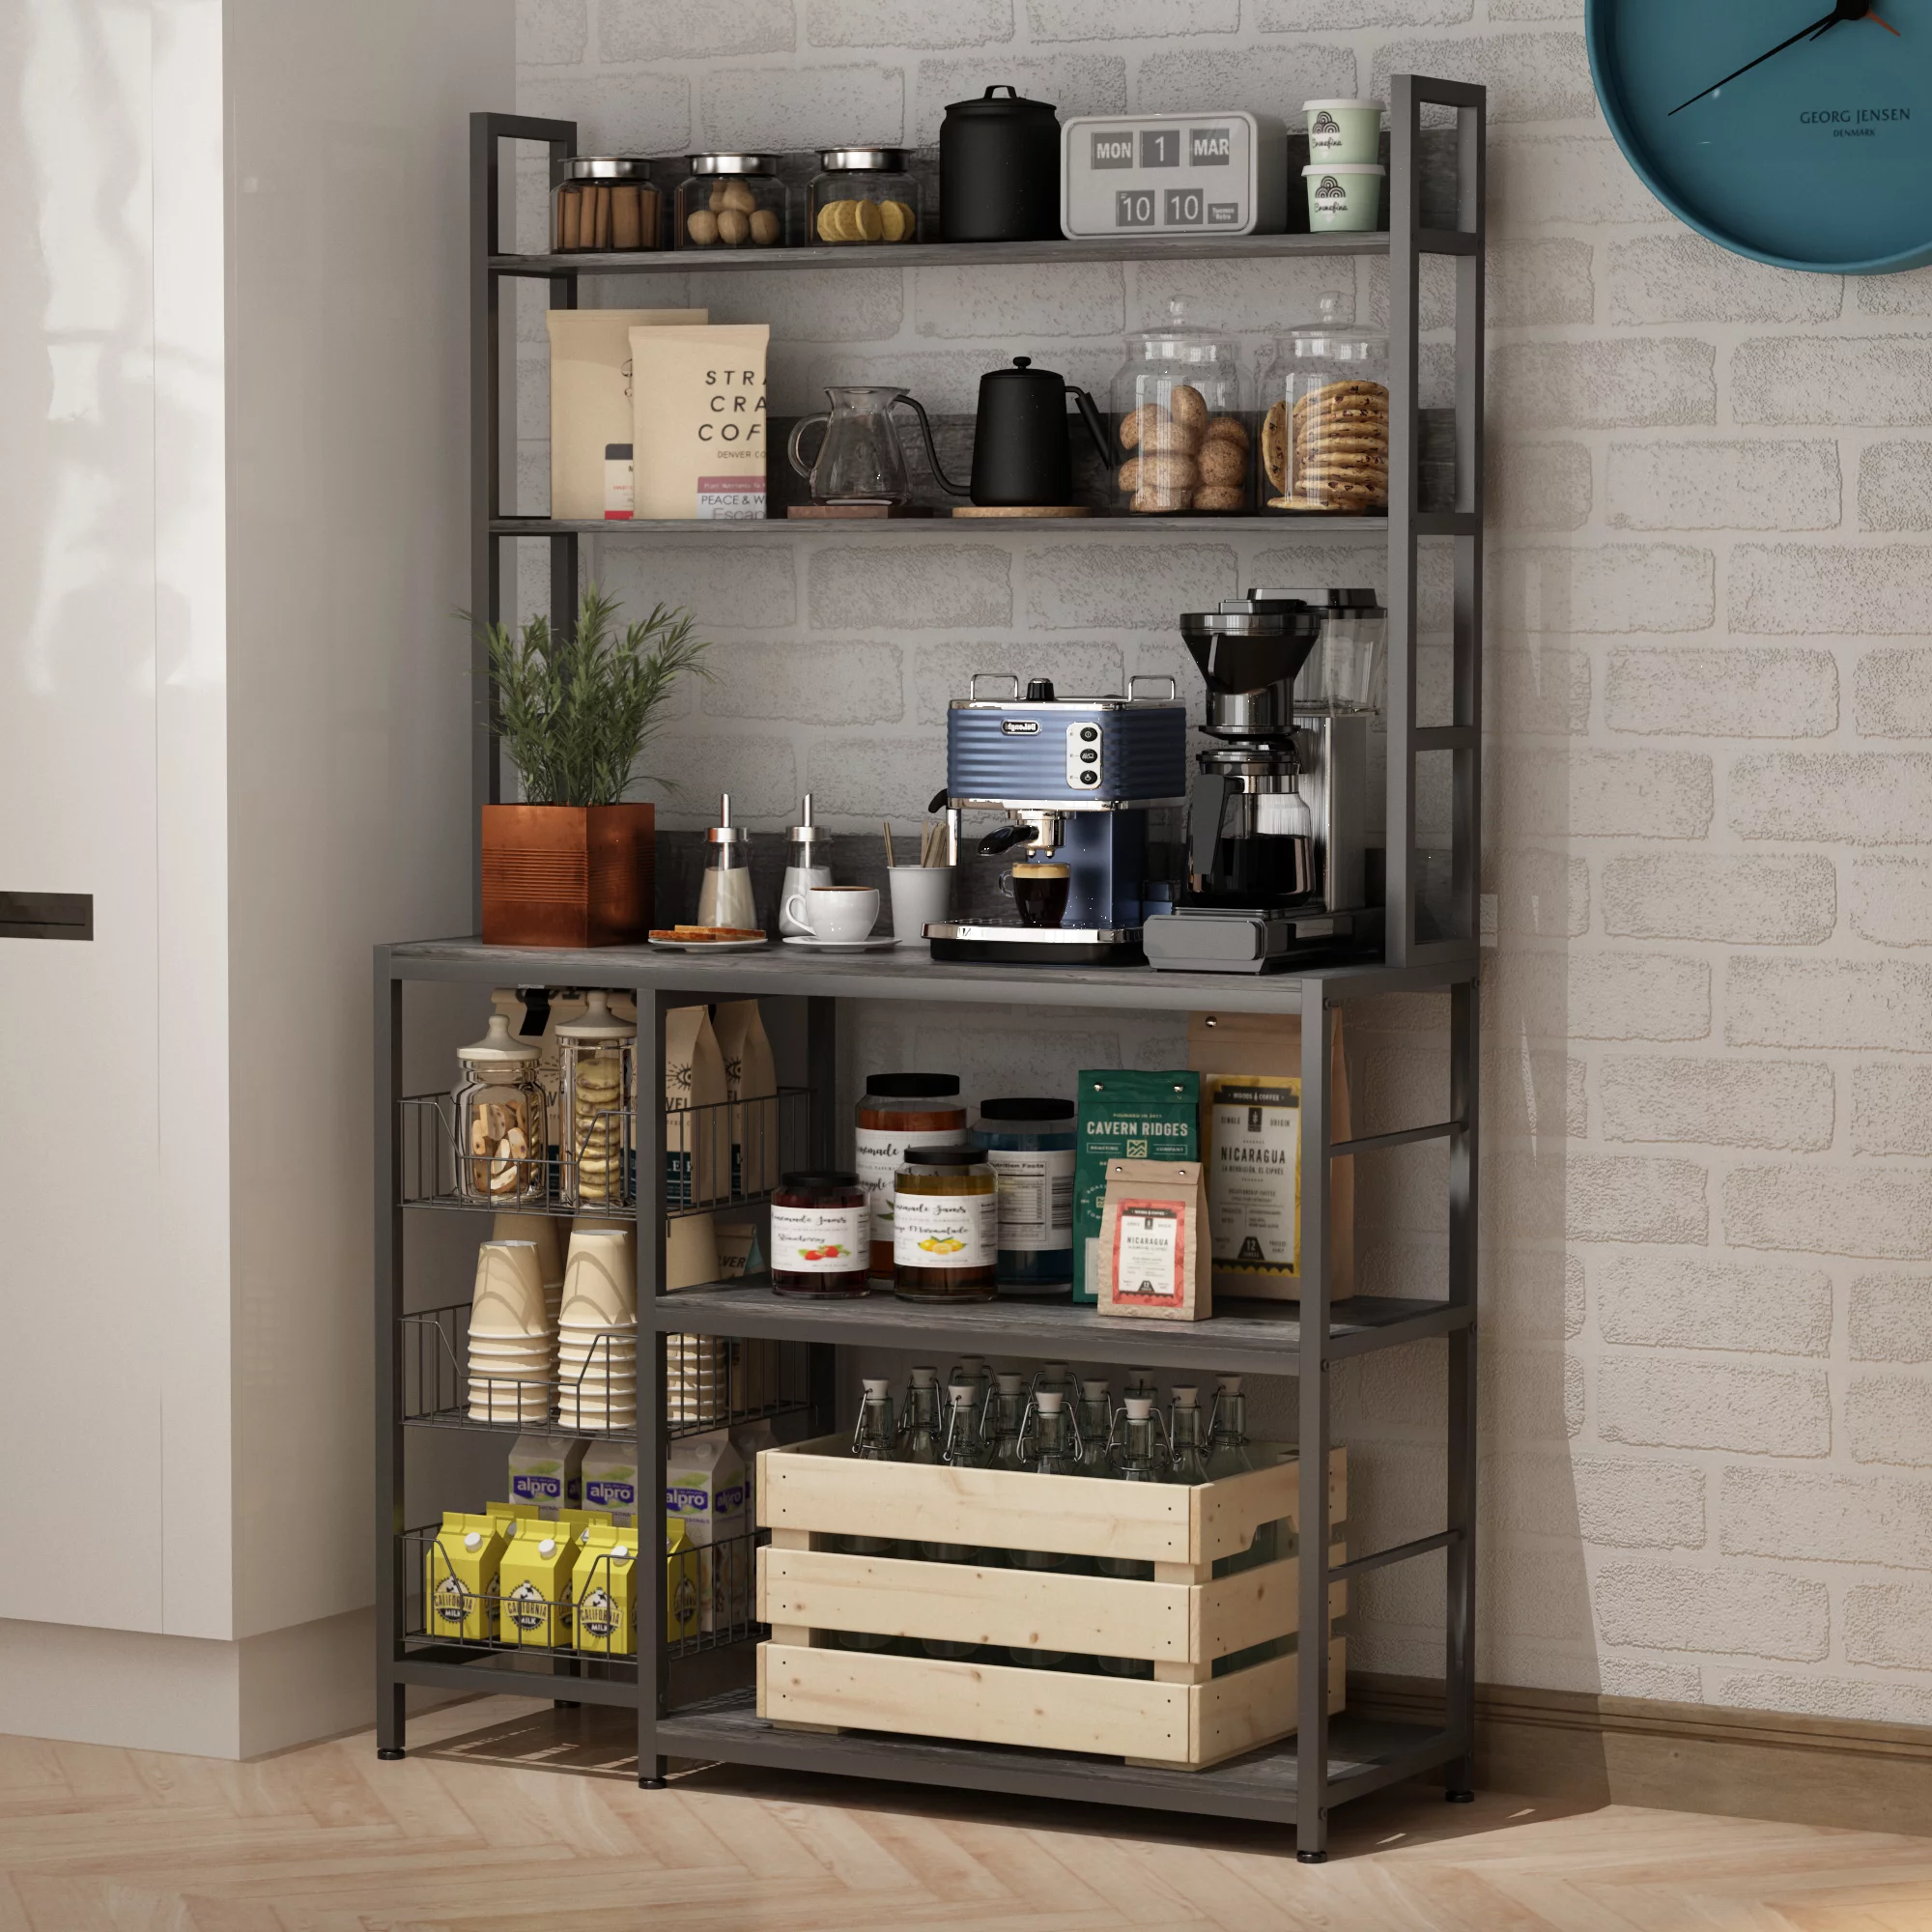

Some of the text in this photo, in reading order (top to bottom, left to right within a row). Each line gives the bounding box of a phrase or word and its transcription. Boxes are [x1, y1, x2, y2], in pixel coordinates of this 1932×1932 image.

[1800, 108, 1911, 125] GEORG JENSEN
[1833, 128, 1876, 137] DENMARK
[1096, 136, 1230, 162] MON 1 MAR
[1122, 195, 1199, 221] 10 10
[697, 423, 761, 441] COF
[718, 450, 752, 459] DENVER
[701, 495, 766, 505] PEACE & W
[1087, 1121, 1188, 1137] CAVERN RIDGES
[1220, 1146, 1286, 1164] NICARAGUA
[1126, 1236, 1169, 1246] NICARAGUA
[1246, 1239, 1257, 1251] 12
[517, 1476, 557, 1496] alpro
[590, 1482, 631, 1501] alpro
[666, 1489, 705, 1509] alpro
[507, 1602, 547, 1618] CAFORNIA
